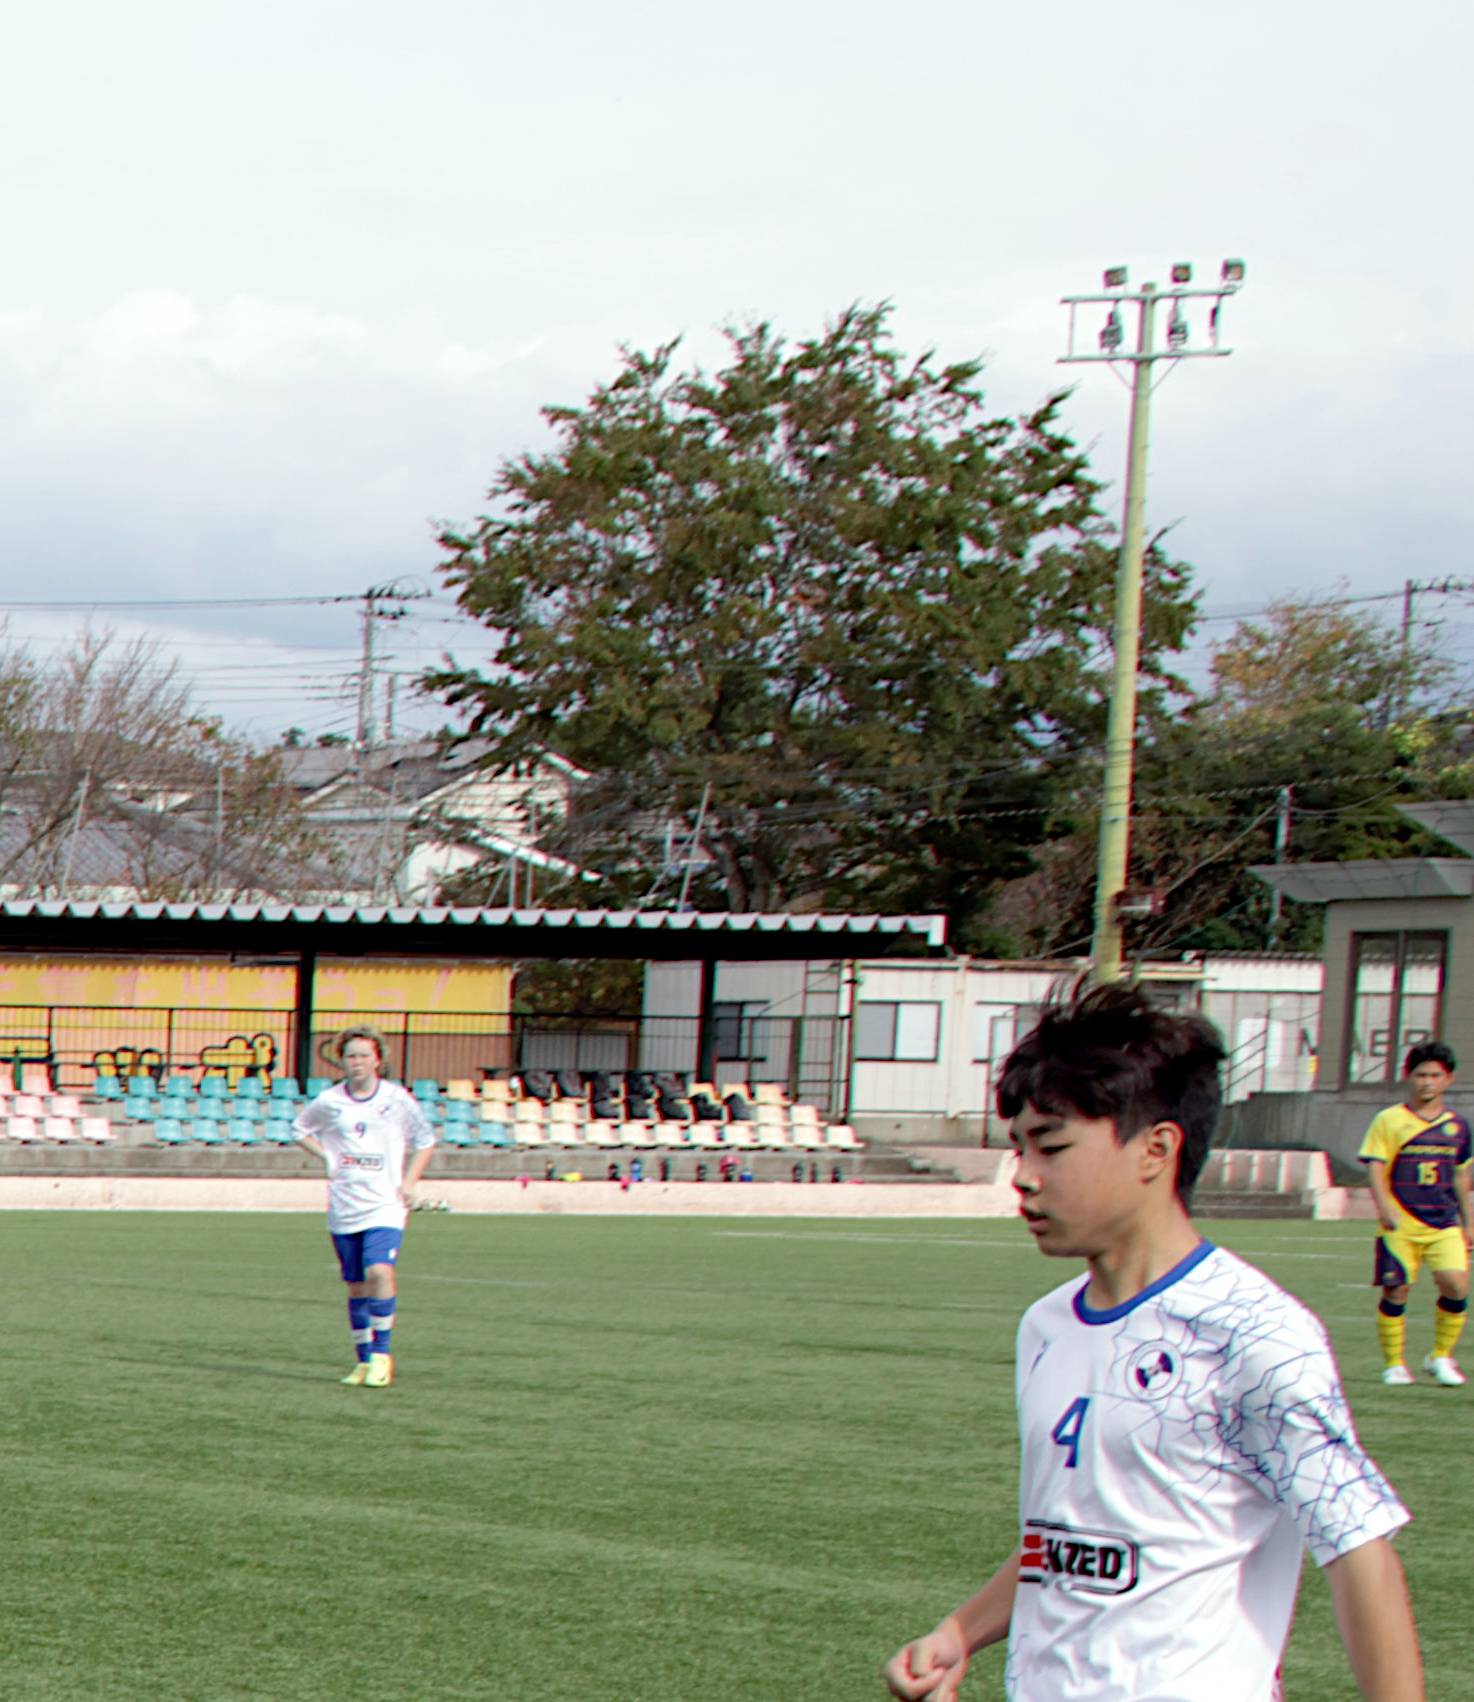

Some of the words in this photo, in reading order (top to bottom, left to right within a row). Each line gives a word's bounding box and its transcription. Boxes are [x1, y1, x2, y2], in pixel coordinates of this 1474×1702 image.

[355, 1121, 366, 1139] 9
[1417, 1162, 1440, 1185] 15
[1051, 1397, 1090, 1469] 4
[1044, 1539, 1125, 1580] NZED
